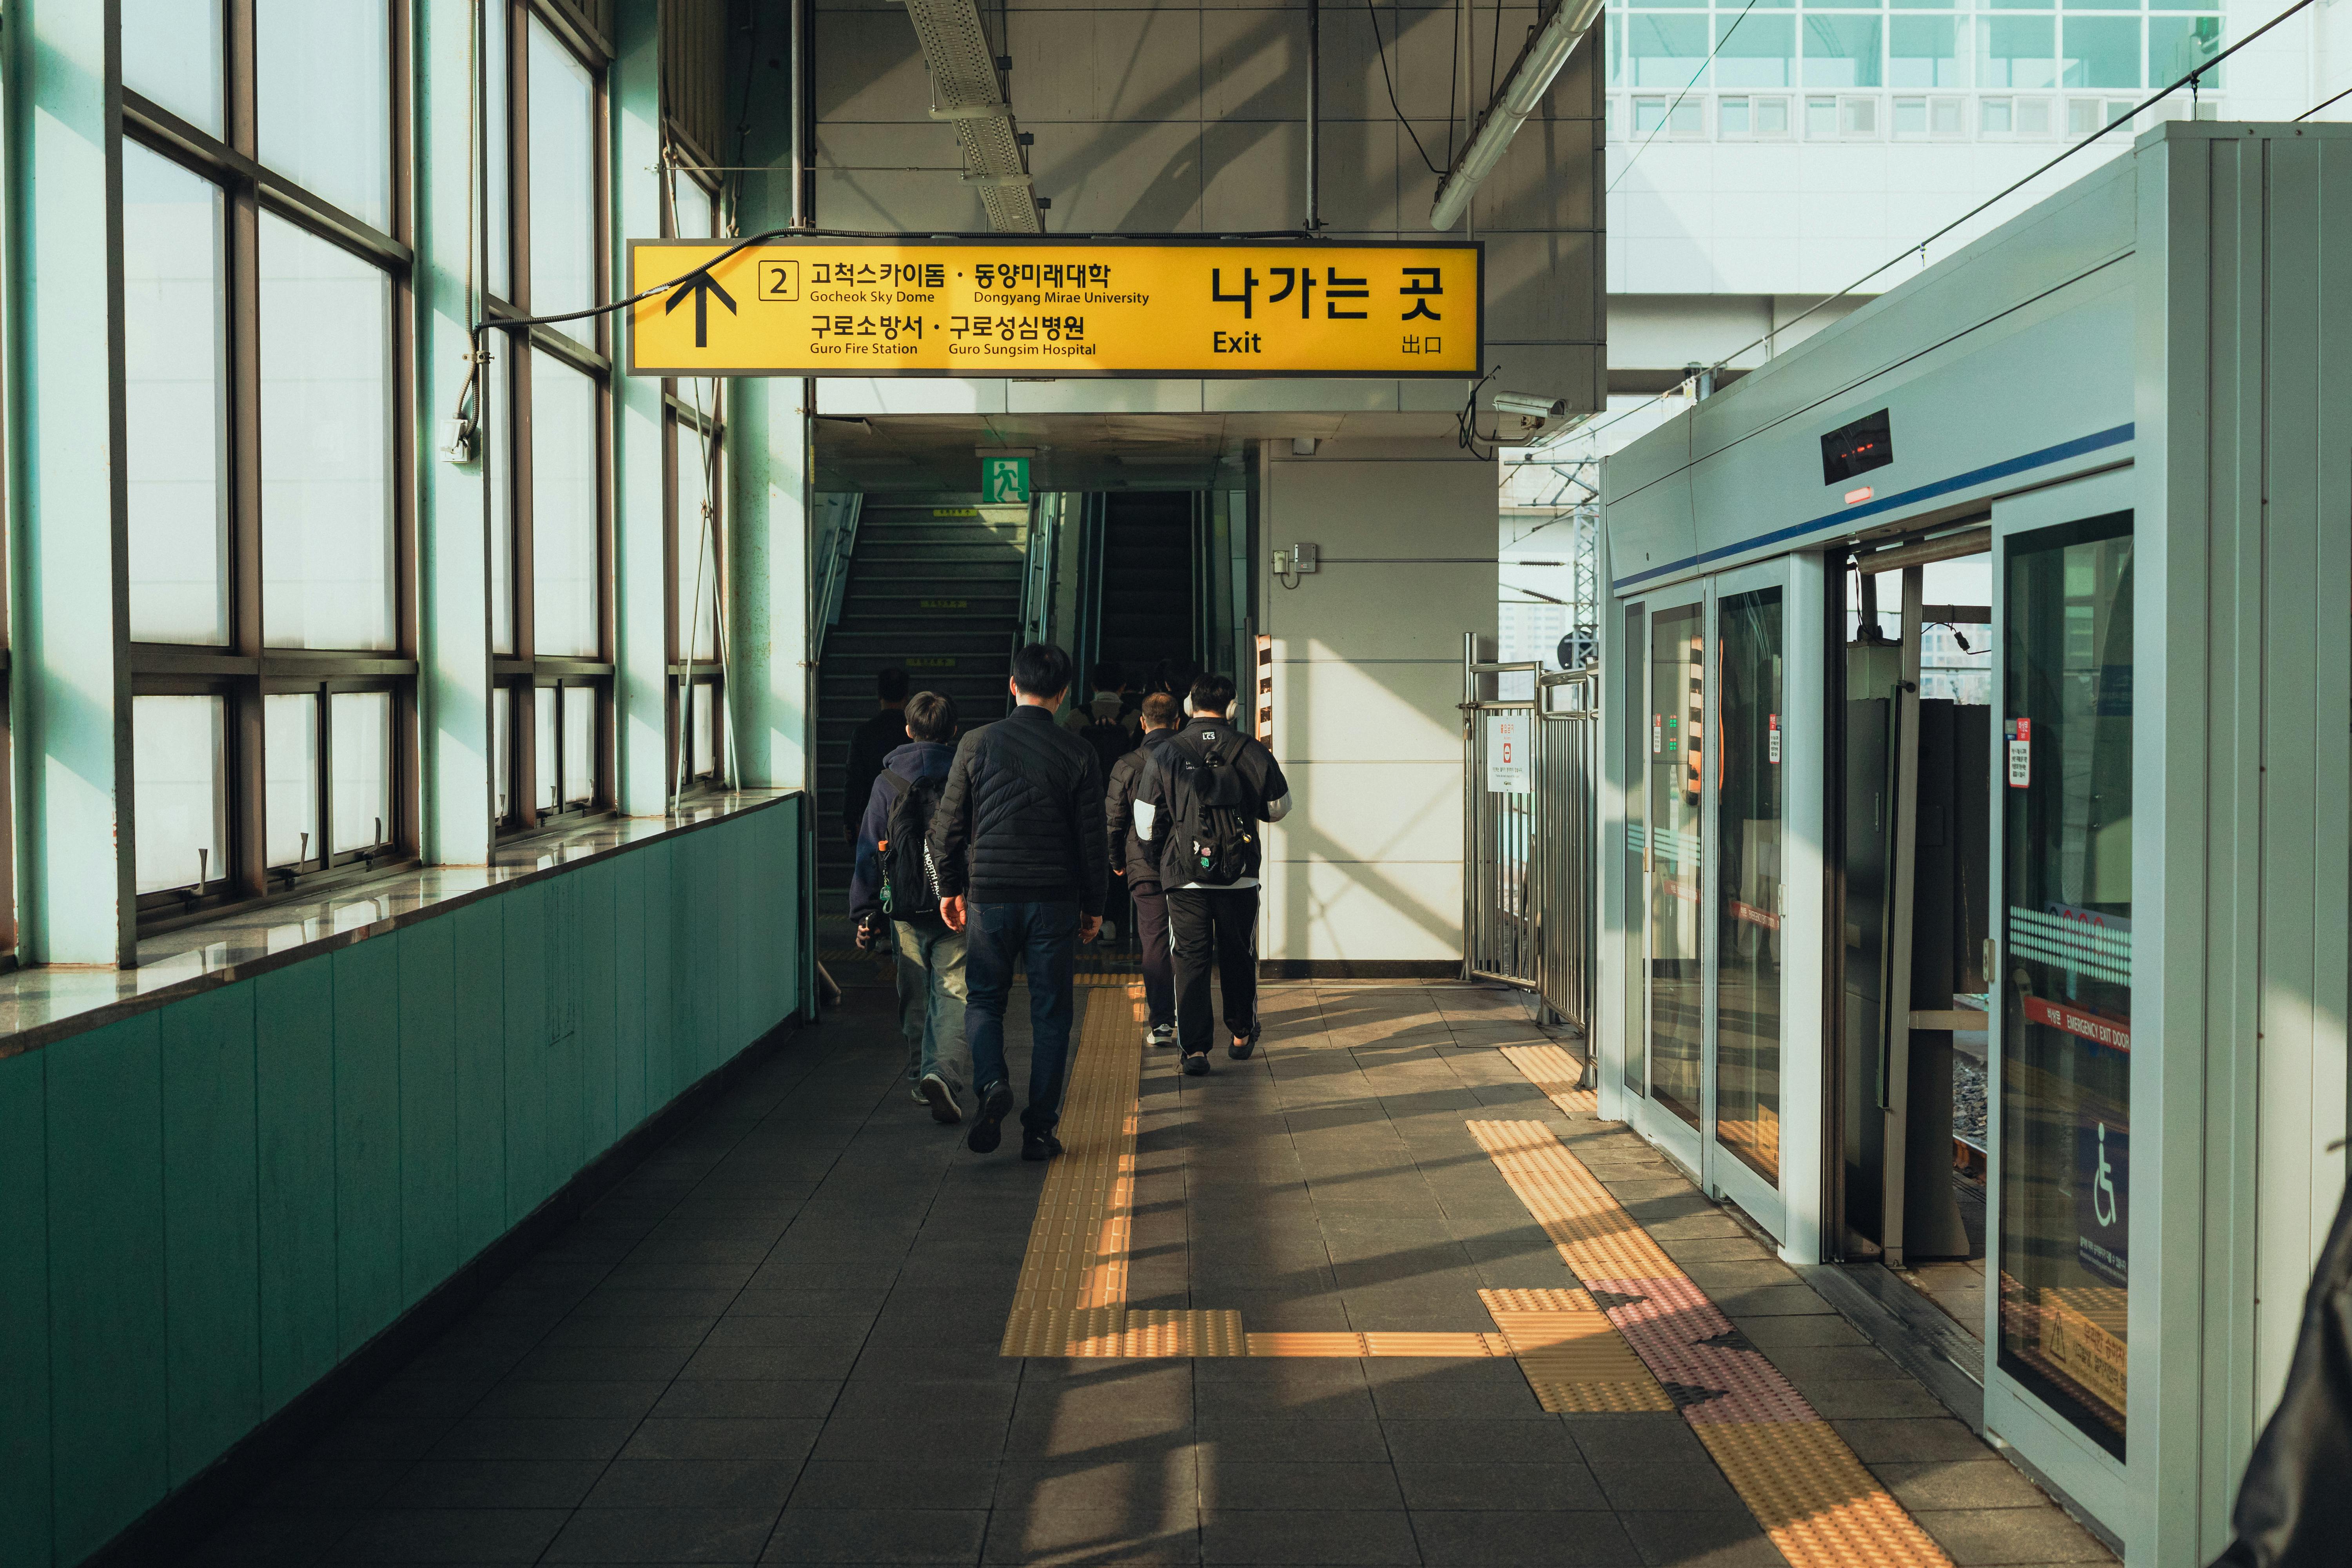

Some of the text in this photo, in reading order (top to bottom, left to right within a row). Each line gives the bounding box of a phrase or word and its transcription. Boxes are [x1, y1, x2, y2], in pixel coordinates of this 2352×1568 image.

[770, 268, 787, 294] 2
[812, 262, 945, 288] 고척스카이돔
[975, 263, 1111, 289] 동양미래대학
[810, 290, 1149, 305] Gocheok Sky Dome Dongyang Mirae University
[1212, 267, 1443, 321] 나가는 곳
[811, 316, 922, 340] 구로소방서
[950, 316, 1084, 341] 구로성심병원
[810, 343, 1096, 357] Guro Fire Station Guro Sungsim Hospital
[1214, 331, 1261, 353] Exit
[1402, 334, 1441, 355] 出口
[1501, 724, 1514, 733] 출입금지
[925, 853, 938, 880] NORTH
[2047, 1008, 2130, 1049] 비상문 EMERGENCY EXIT DOOR
